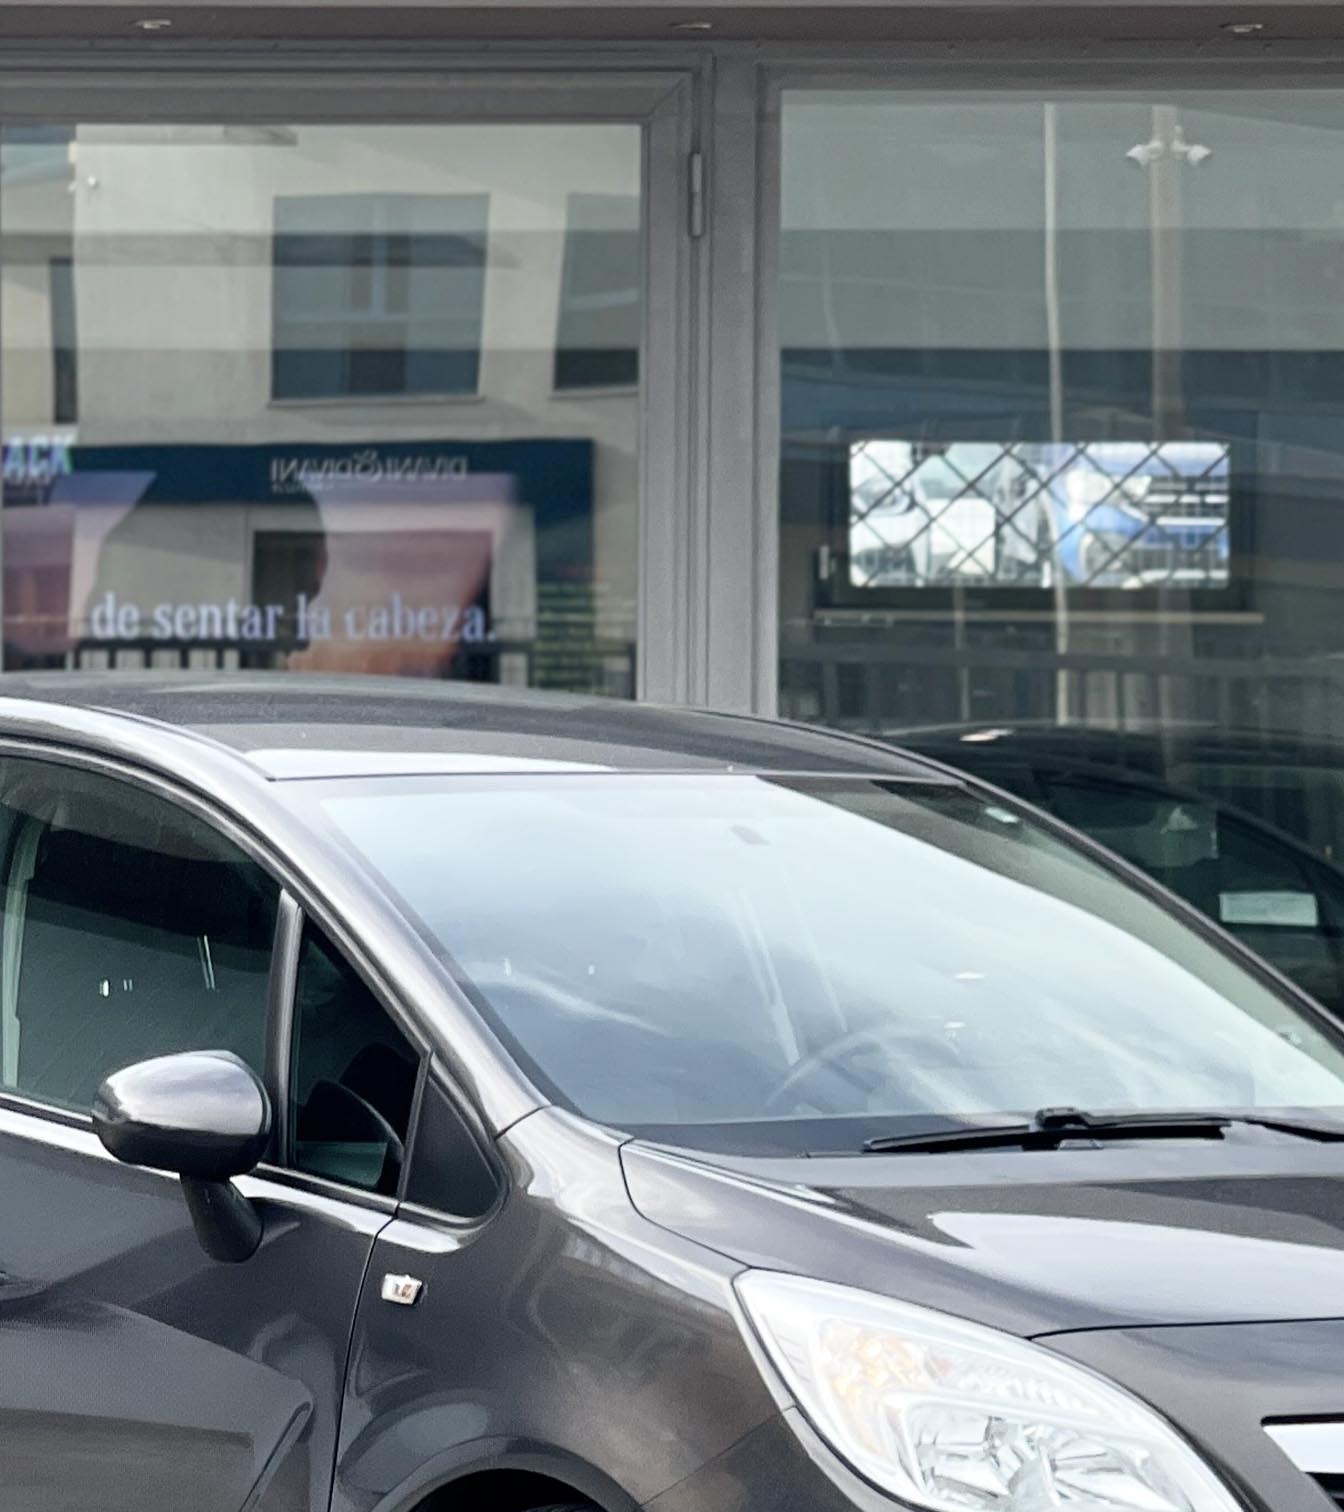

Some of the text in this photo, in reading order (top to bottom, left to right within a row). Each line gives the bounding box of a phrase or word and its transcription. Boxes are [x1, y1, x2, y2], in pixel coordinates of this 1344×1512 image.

[91, 592, 497, 642] de sentar la cabeza.
